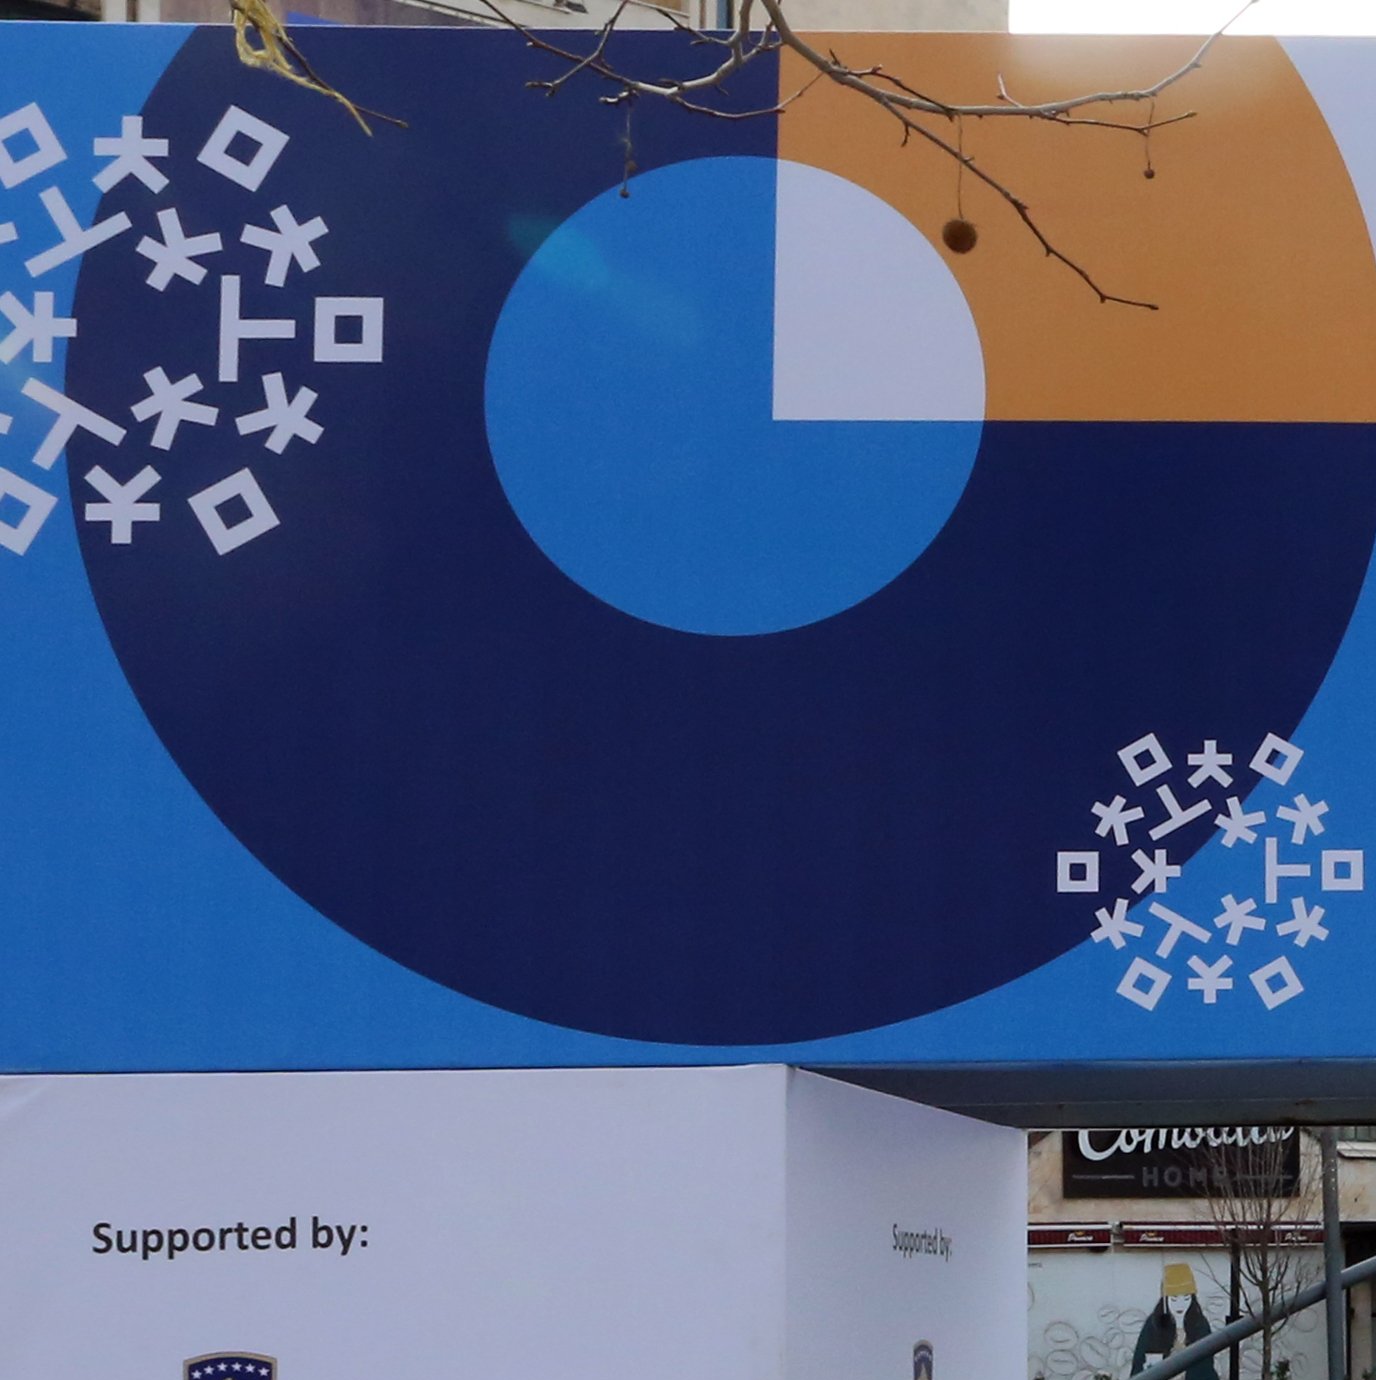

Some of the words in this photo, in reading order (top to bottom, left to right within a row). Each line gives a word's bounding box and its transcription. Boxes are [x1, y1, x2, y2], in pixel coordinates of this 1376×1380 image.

[93, 1217, 296, 1260] Supported
[312, 1216, 368, 1255] by:
[892, 1224, 938, 1259] Supported
[940, 1229, 952, 1262] by:
